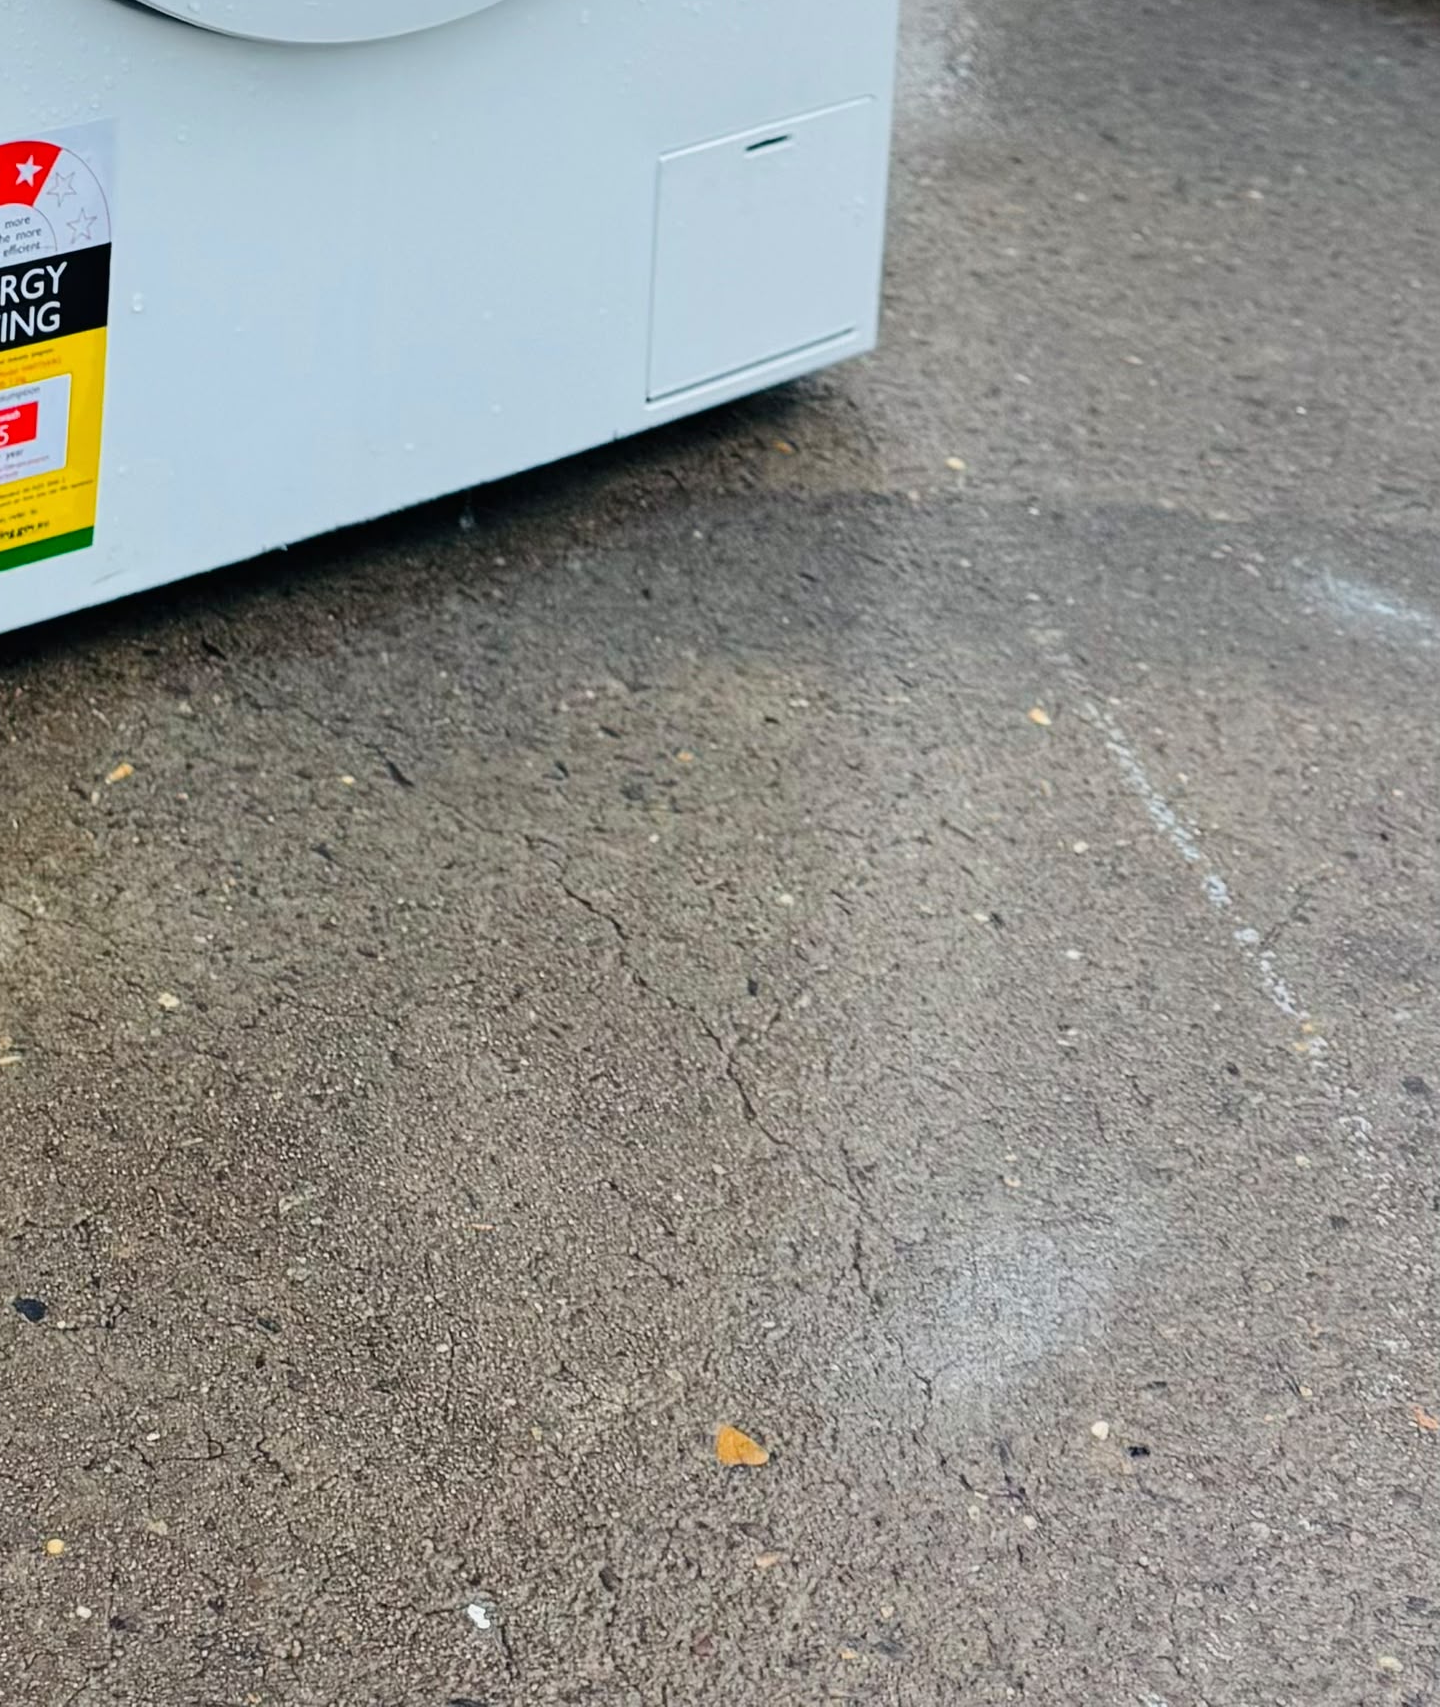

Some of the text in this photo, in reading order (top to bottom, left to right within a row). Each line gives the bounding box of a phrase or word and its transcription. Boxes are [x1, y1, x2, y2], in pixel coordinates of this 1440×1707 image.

[4, 216, 31, 227] more
[15, 228, 42, 240] more
[3, 242, 41, 258] efficient
